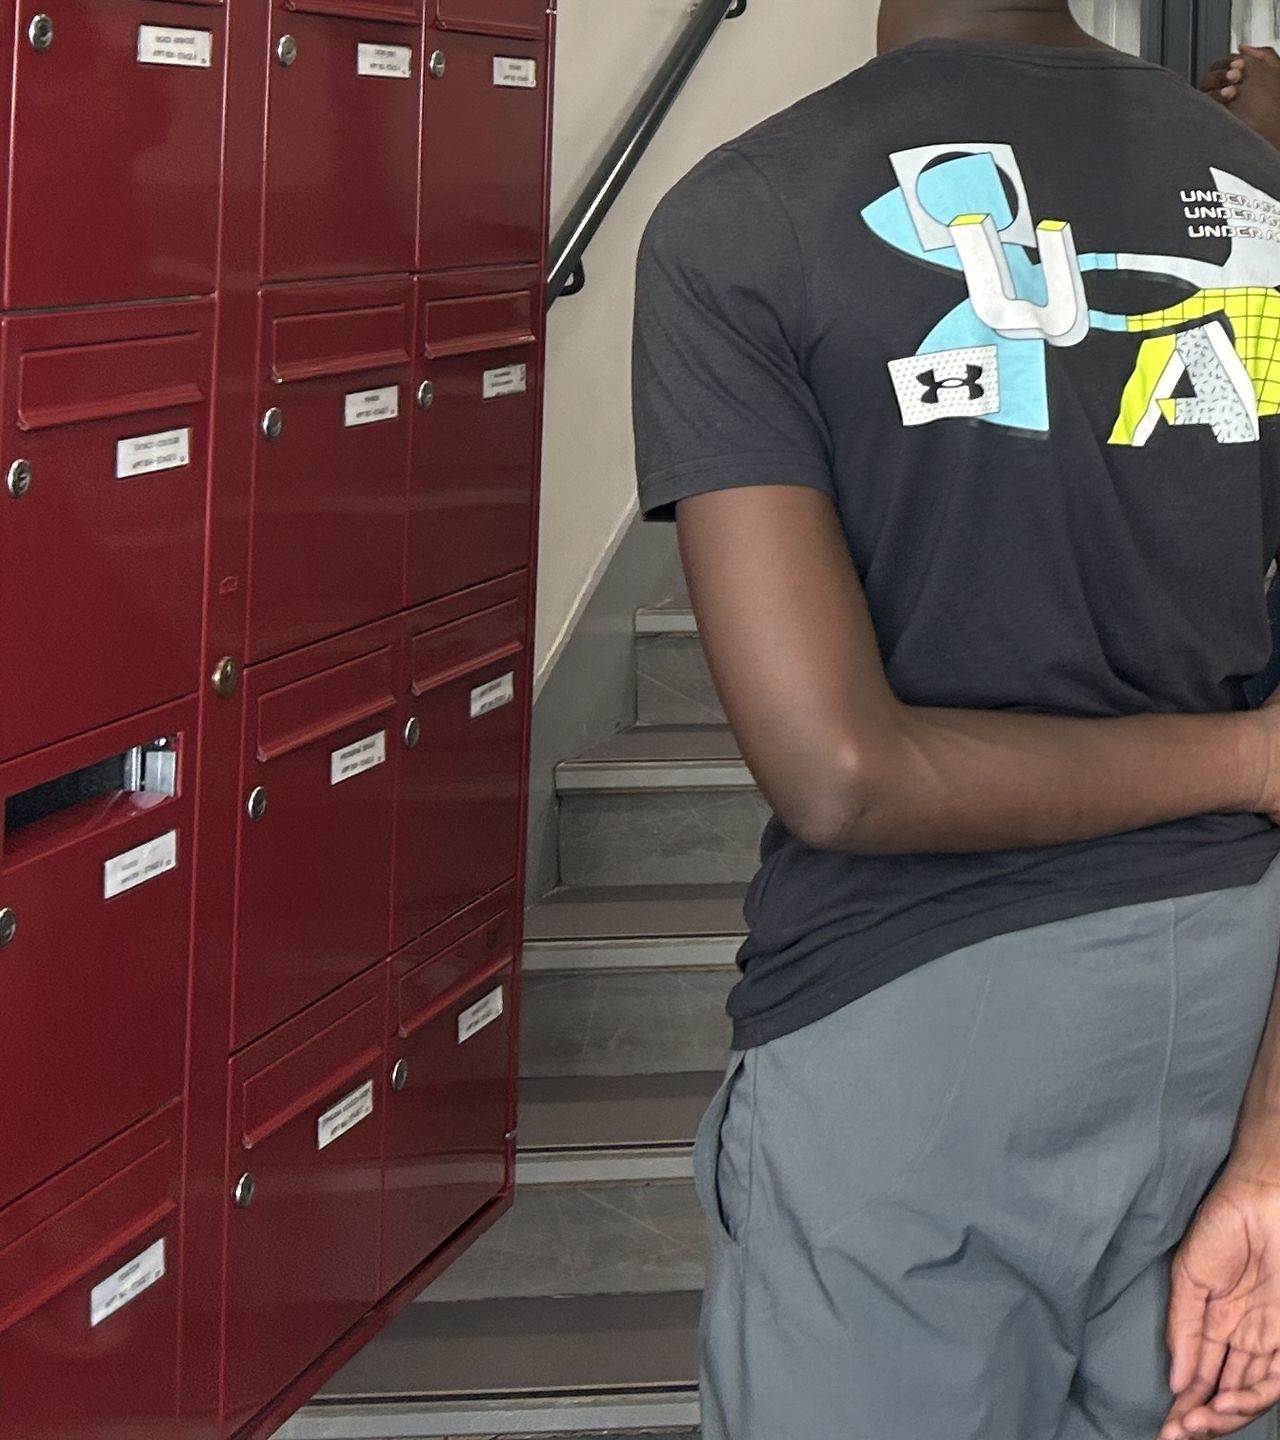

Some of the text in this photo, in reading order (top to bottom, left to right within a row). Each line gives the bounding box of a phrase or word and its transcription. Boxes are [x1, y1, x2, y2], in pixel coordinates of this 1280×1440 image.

[1180, 190, 1251, 207] UNDER
[1184, 206, 1257, 222] UNDER
[1188, 225, 1262, 240] UNDER
